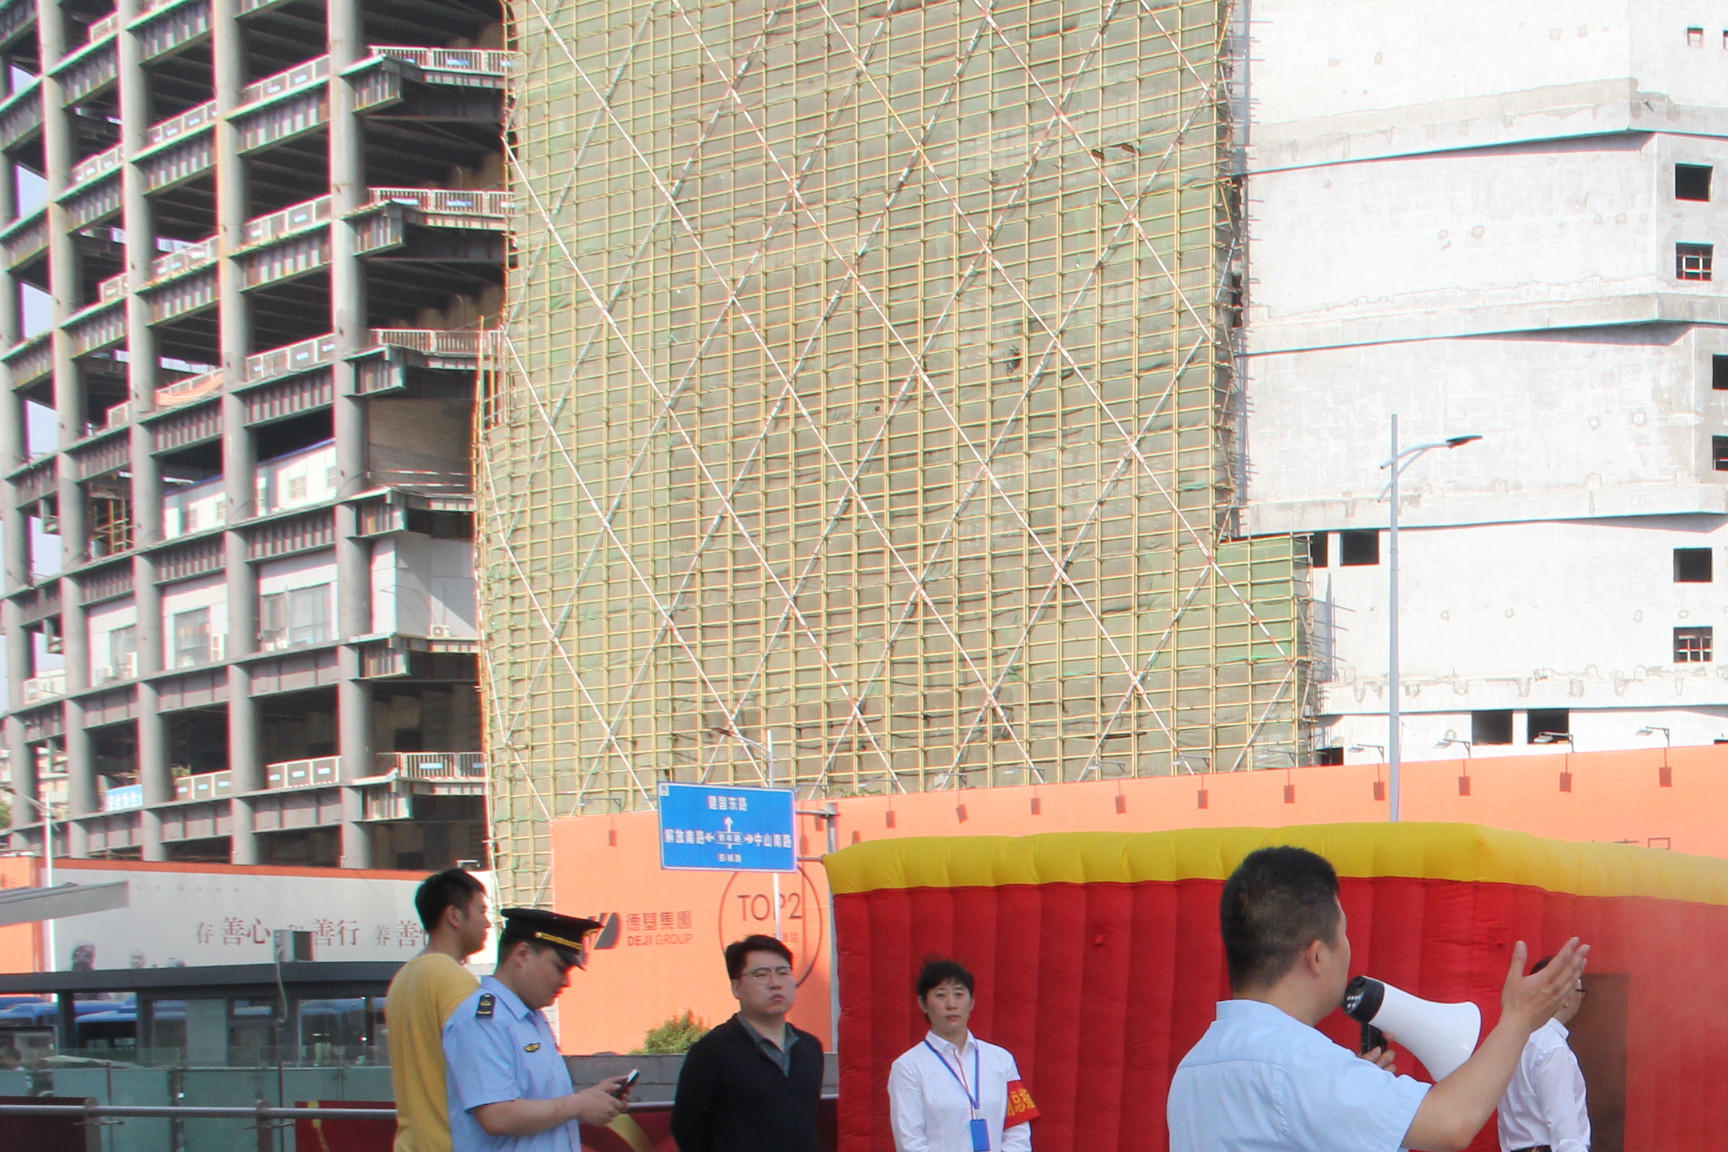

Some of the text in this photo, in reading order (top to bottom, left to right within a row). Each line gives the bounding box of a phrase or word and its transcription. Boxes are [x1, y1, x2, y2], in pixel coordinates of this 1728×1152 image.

[754, 833, 792, 848] 中山南路
[195, 916, 272, 946] 存善心
[627, 933, 693, 946] DEJI GROUP
